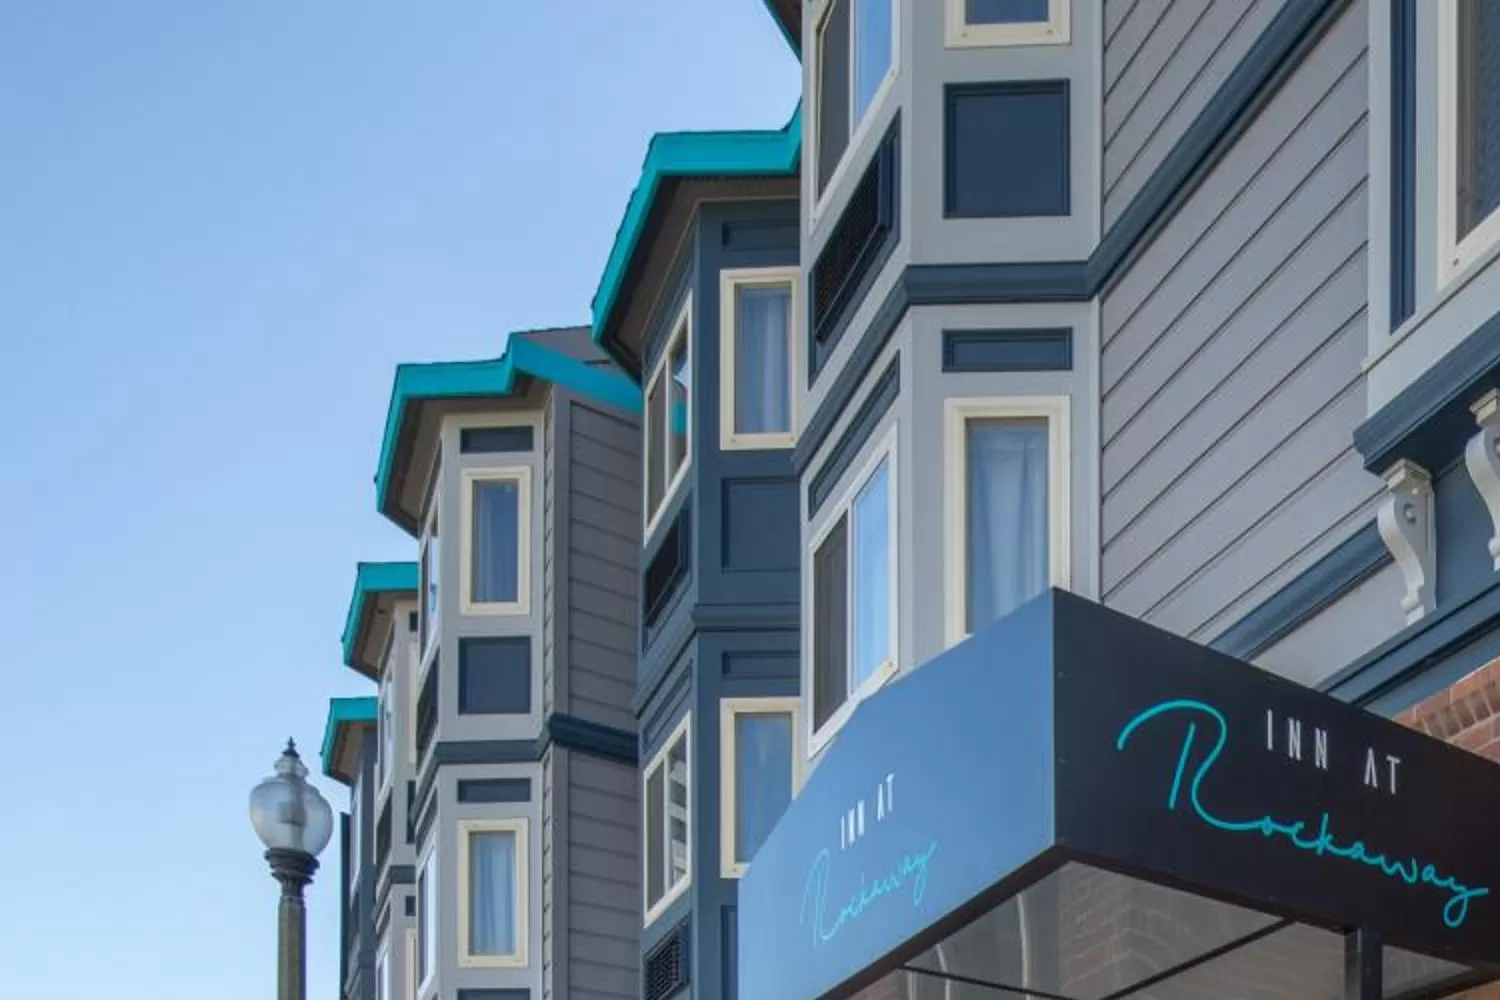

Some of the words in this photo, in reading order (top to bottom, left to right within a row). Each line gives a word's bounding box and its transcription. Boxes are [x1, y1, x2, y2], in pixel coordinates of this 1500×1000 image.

[1265, 708, 1329, 770] INN
[1363, 747, 1401, 796] AT
[840, 799, 866, 850] INN
[877, 772, 896, 822] AT
[1116, 699, 1490, 928] Rockaway
[799, 840, 939, 947] Rockaway
